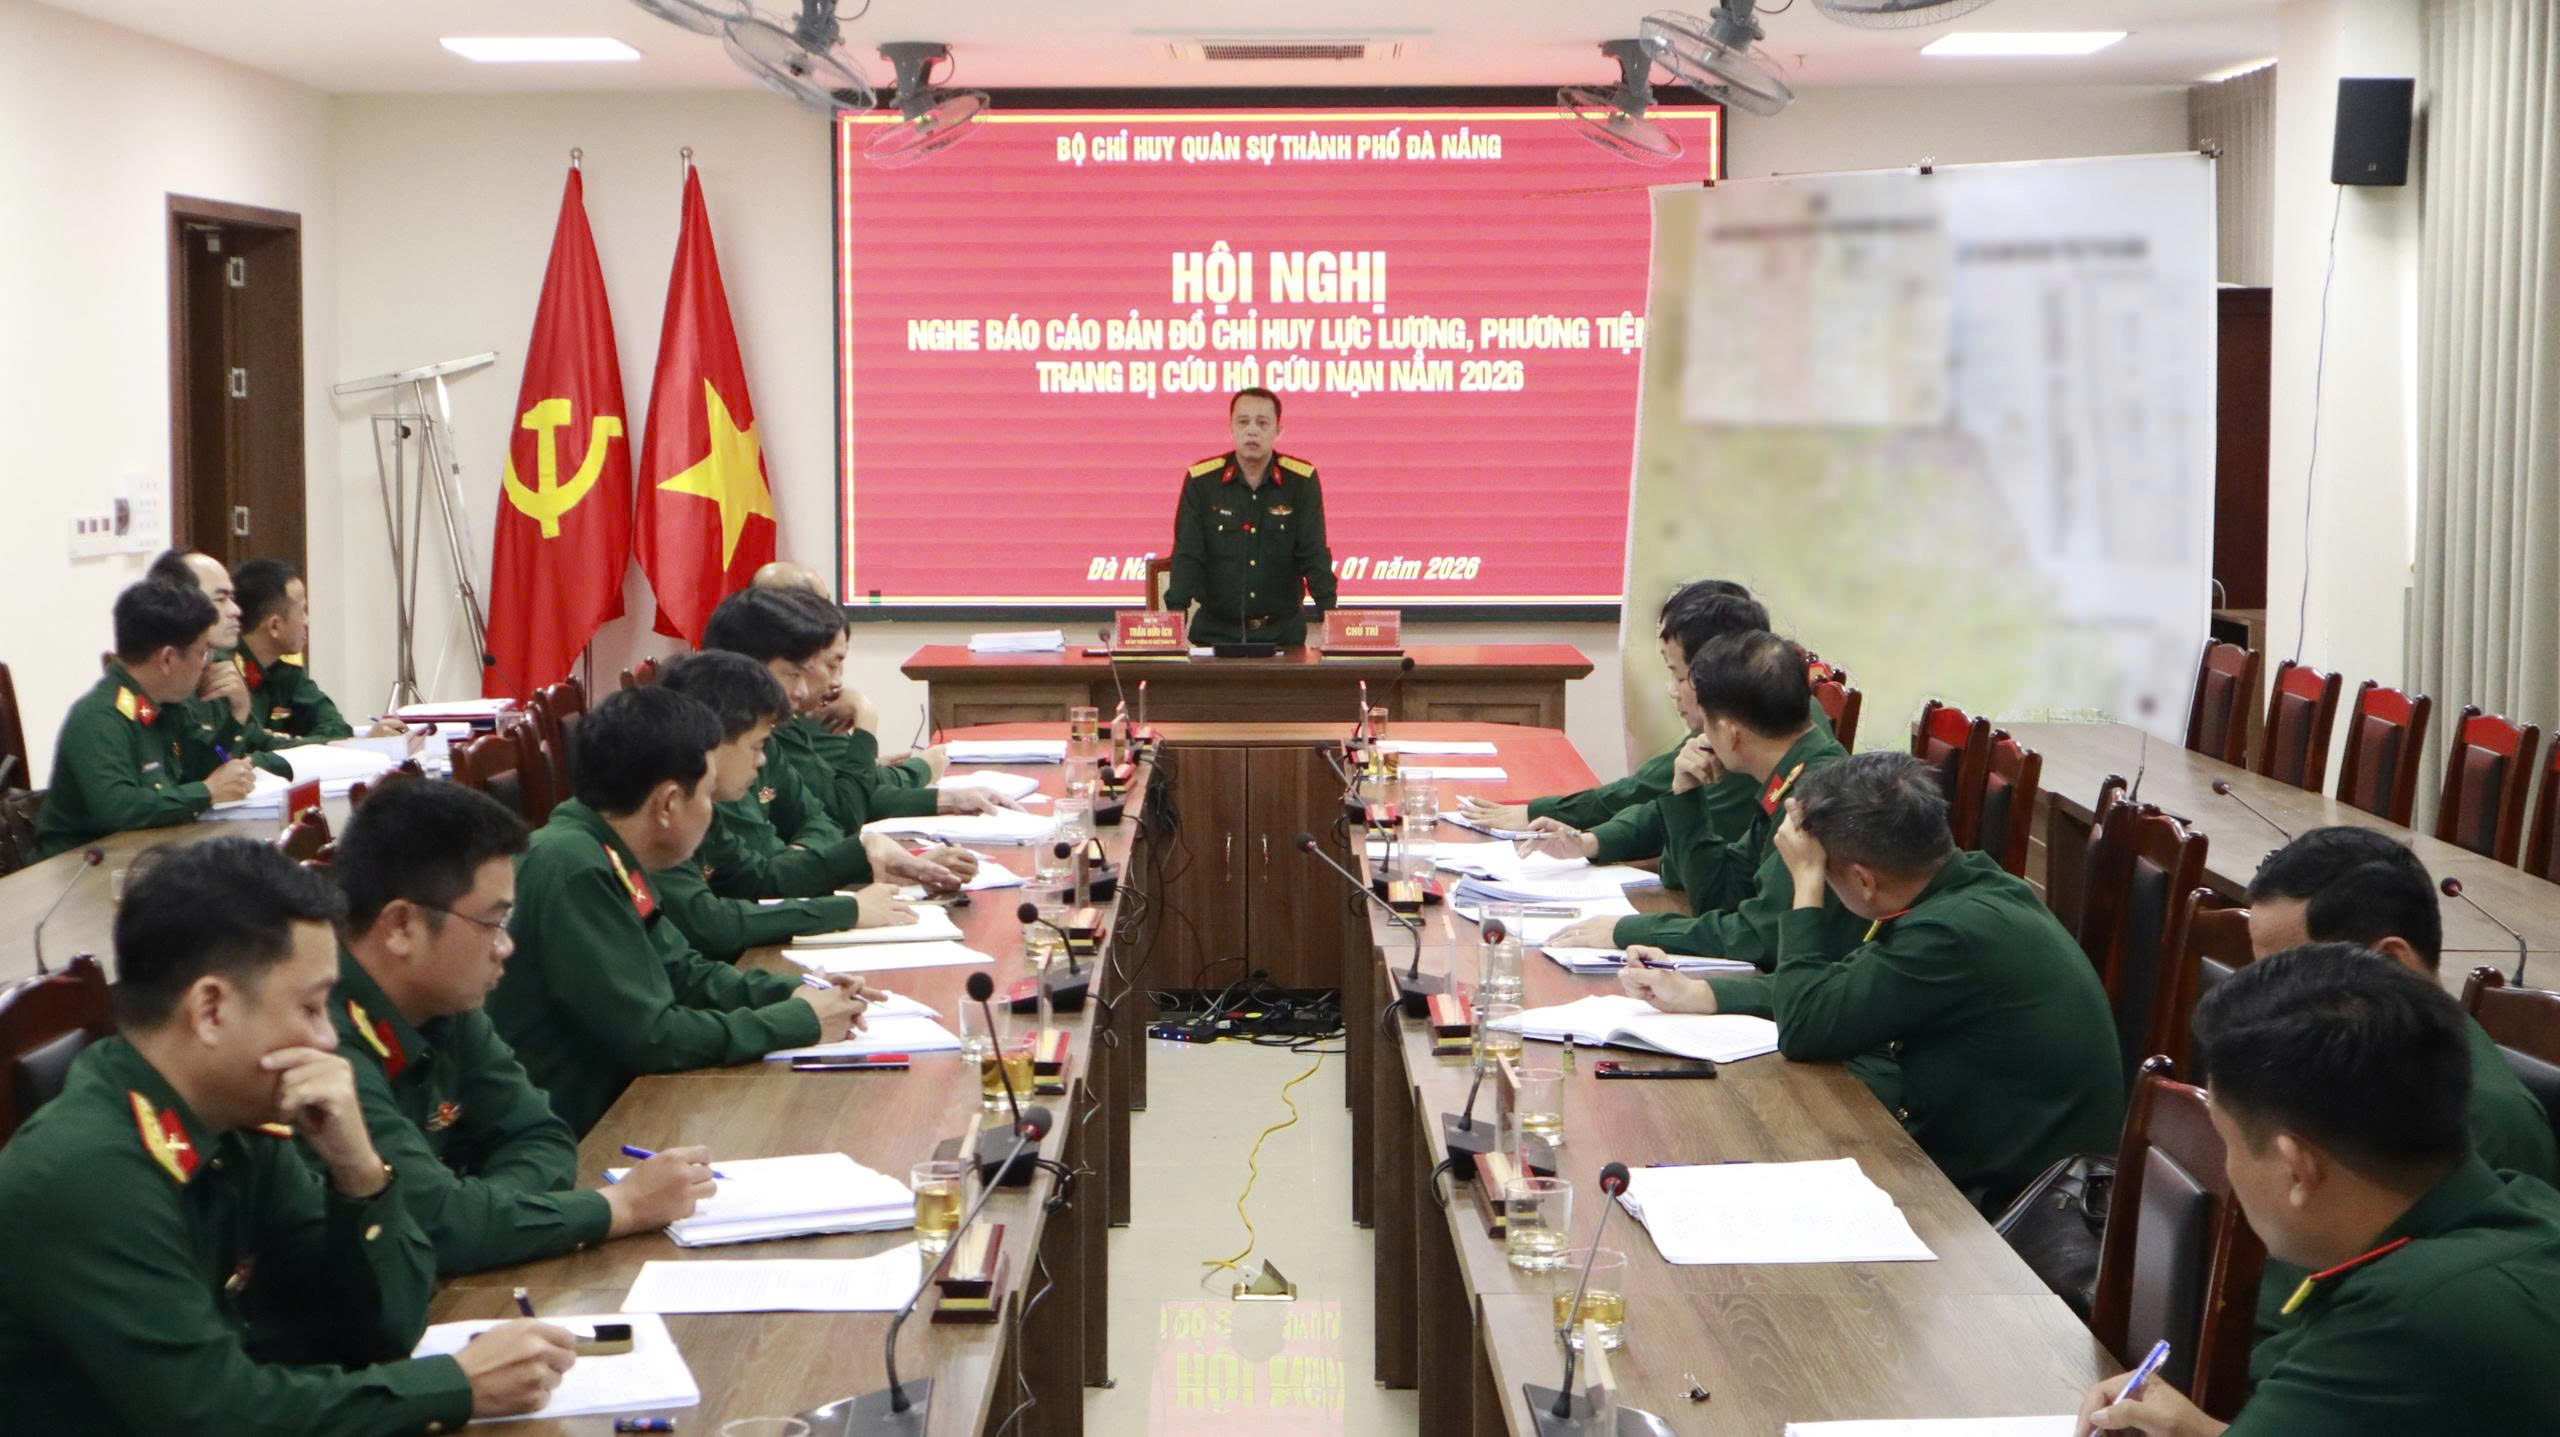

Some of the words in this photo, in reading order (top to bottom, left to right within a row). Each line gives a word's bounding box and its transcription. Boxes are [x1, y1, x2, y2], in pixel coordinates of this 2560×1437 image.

[1056, 131, 1087, 166] BỘ
[1091, 129, 1128, 161] CHỈ
[1133, 136, 1176, 161] HUY
[1181, 131, 1241, 163] QUÂN
[1246, 133, 1278, 166] SỰ
[1280, 130, 1352, 160] THÀNH
[1357, 127, 1401, 160] PHỐ
[1406, 129, 1436, 160] ĐÀ
[1172, 240, 1253, 315] HỘI
[1270, 250, 1387, 314] NGHỊ
[907, 318, 980, 351] NGHE
[985, 313, 1041, 351] BÁO
[1046, 313, 1101, 350] CÁO
[1106, 309, 1163, 350] BẢN
[1212, 308, 1257, 350] CHỈ
[1262, 318, 1315, 349] HUY
[1320, 315, 1372, 356] LỰC
[1378, 315, 1474, 354] LƯỢNG,
[1480, 314, 1590, 349] PHƯƠNG
[1035, 361, 1124, 393] TRANG
[1129, 361, 1156, 399] BỊ
[1162, 355, 1217, 392] CỨU
[1266, 354, 1320, 392] CỨU
[1326, 360, 1384, 398] NẠN
[1459, 360, 1525, 391] 2026
[1087, 556, 1119, 581] Đà
[1340, 556, 1369, 580] 01
[1371, 555, 1422, 580] năm
[1423, 556, 1481, 580] 2026
